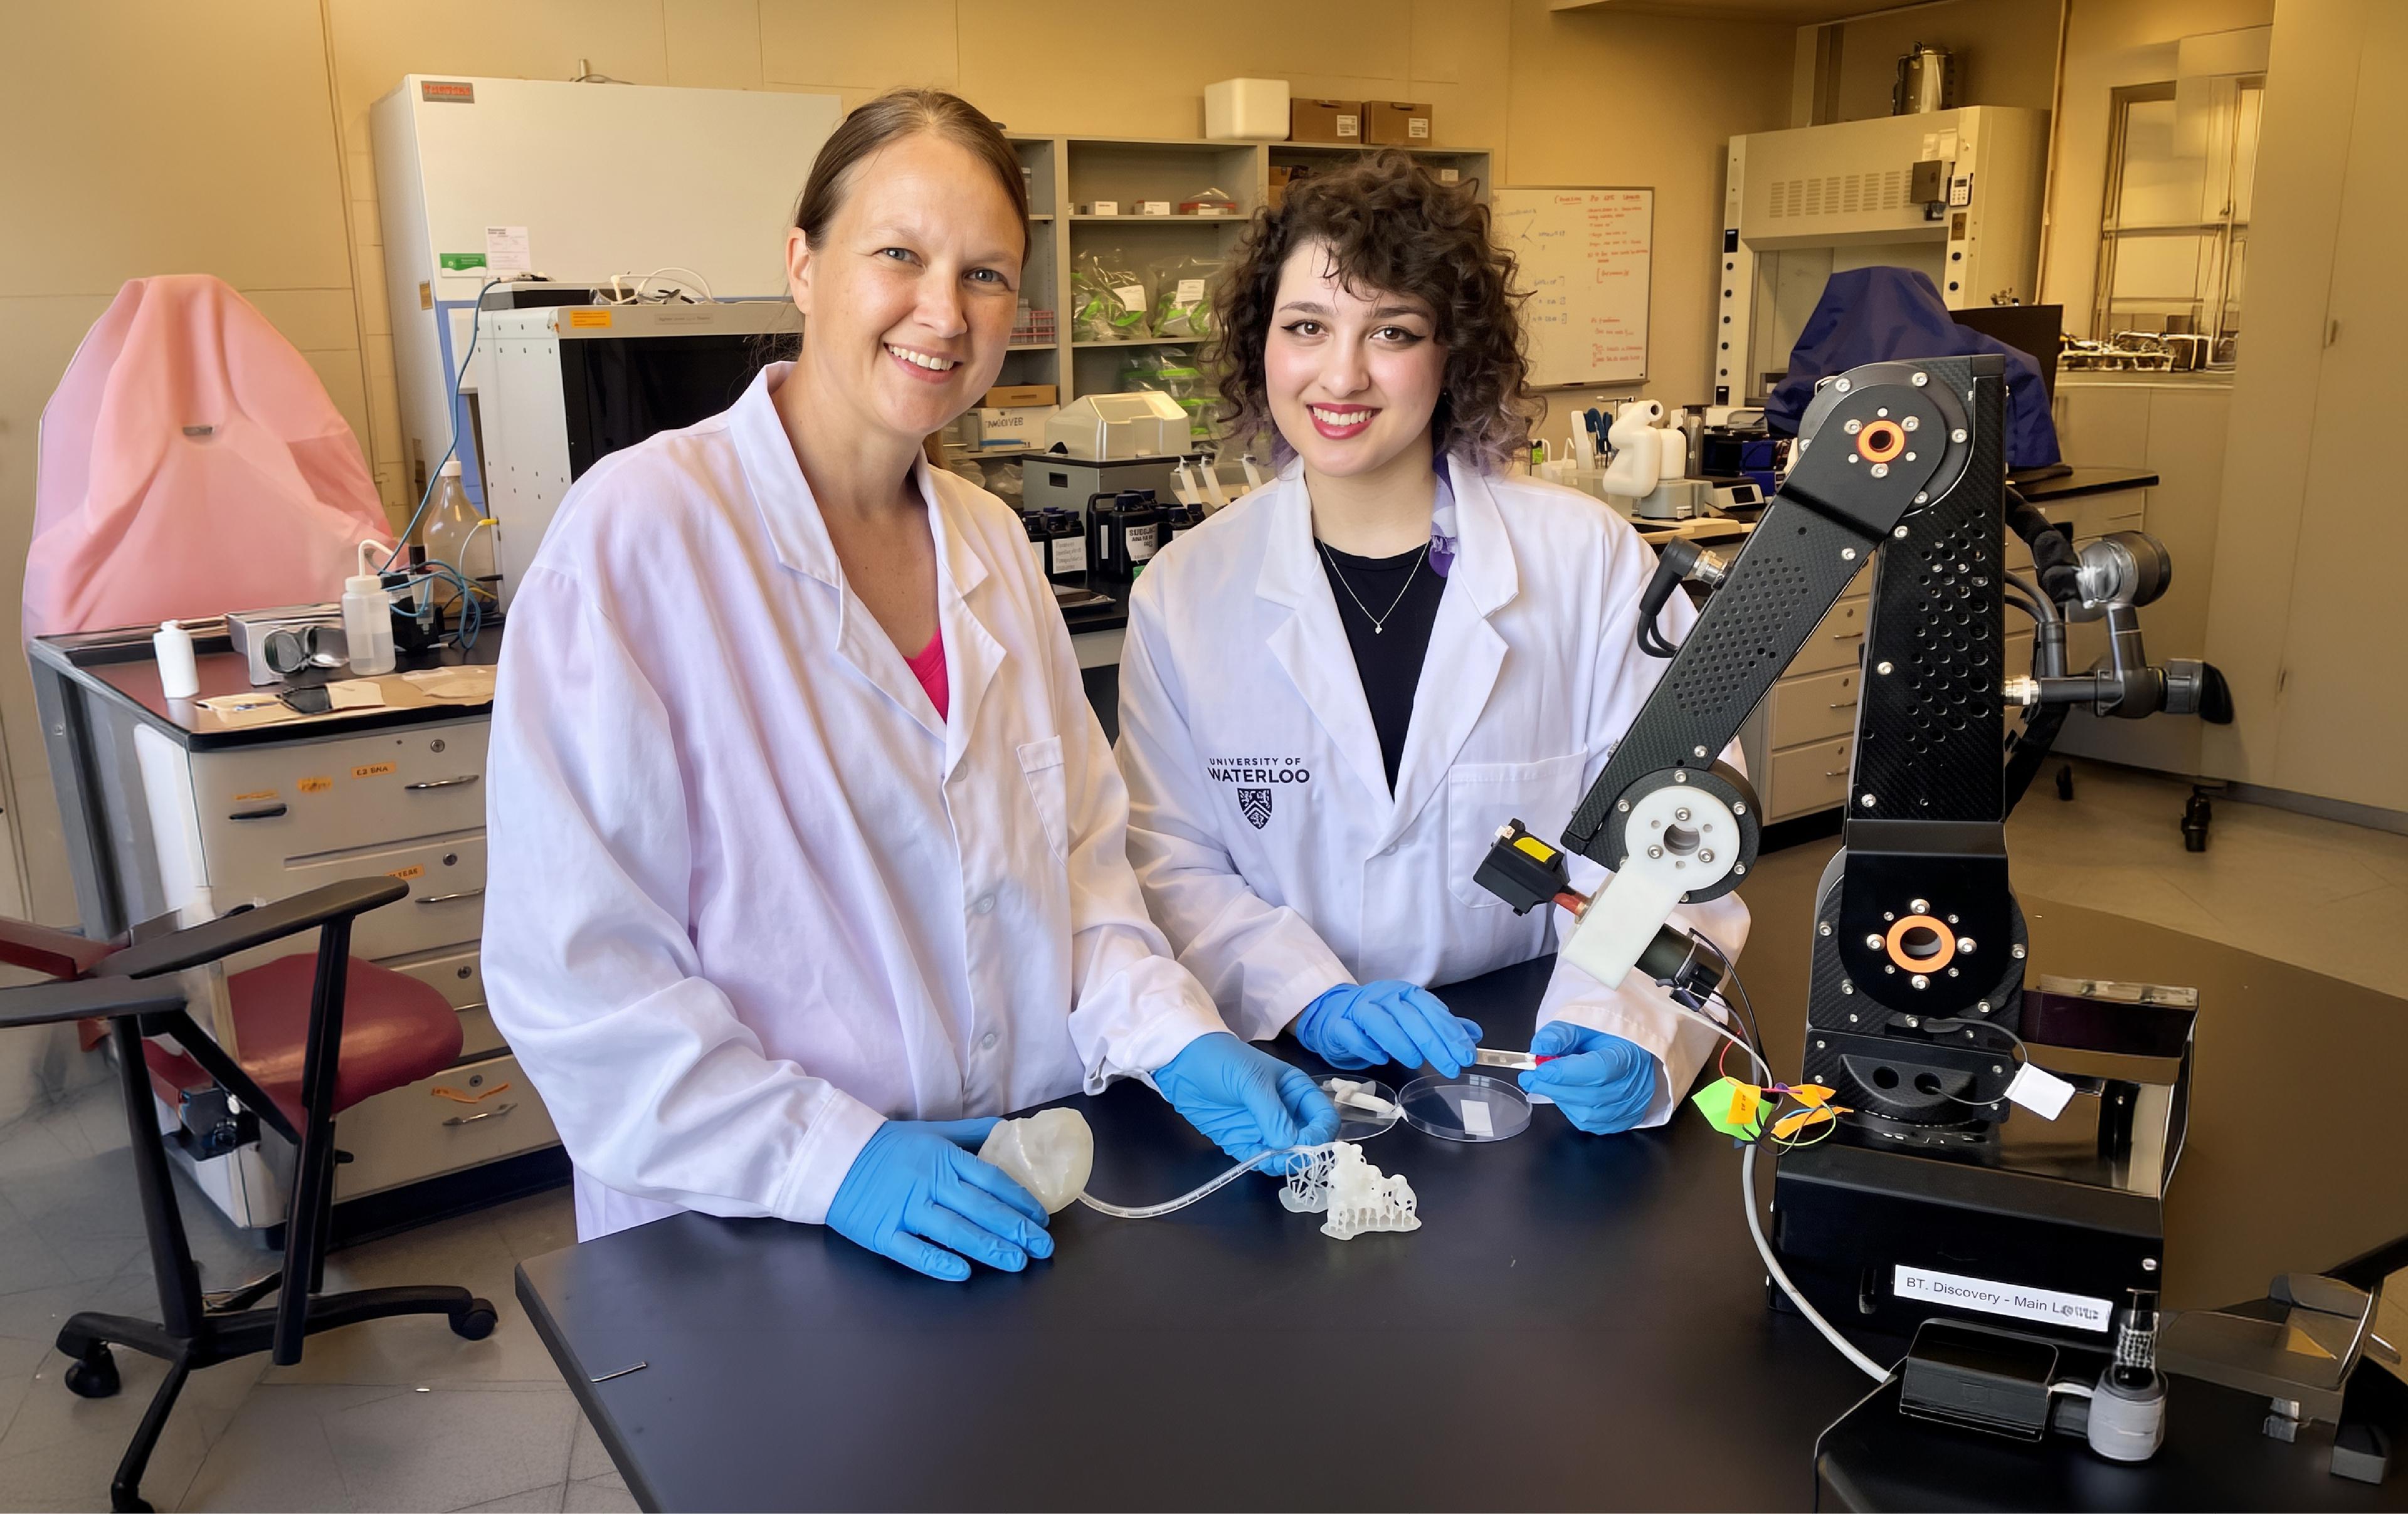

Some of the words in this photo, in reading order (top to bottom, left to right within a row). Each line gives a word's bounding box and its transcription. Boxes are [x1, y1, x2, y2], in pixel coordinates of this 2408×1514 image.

[1209, 757, 1279, 765] UNIVERSITY
[1285, 757, 1301, 765] OF
[1207, 767, 1310, 784] WATERLOO
[1906, 1276, 1929, 1291] BT.
[1933, 1281, 2001, 1305] Discovery
[2014, 1295, 2047, 1312] Main
